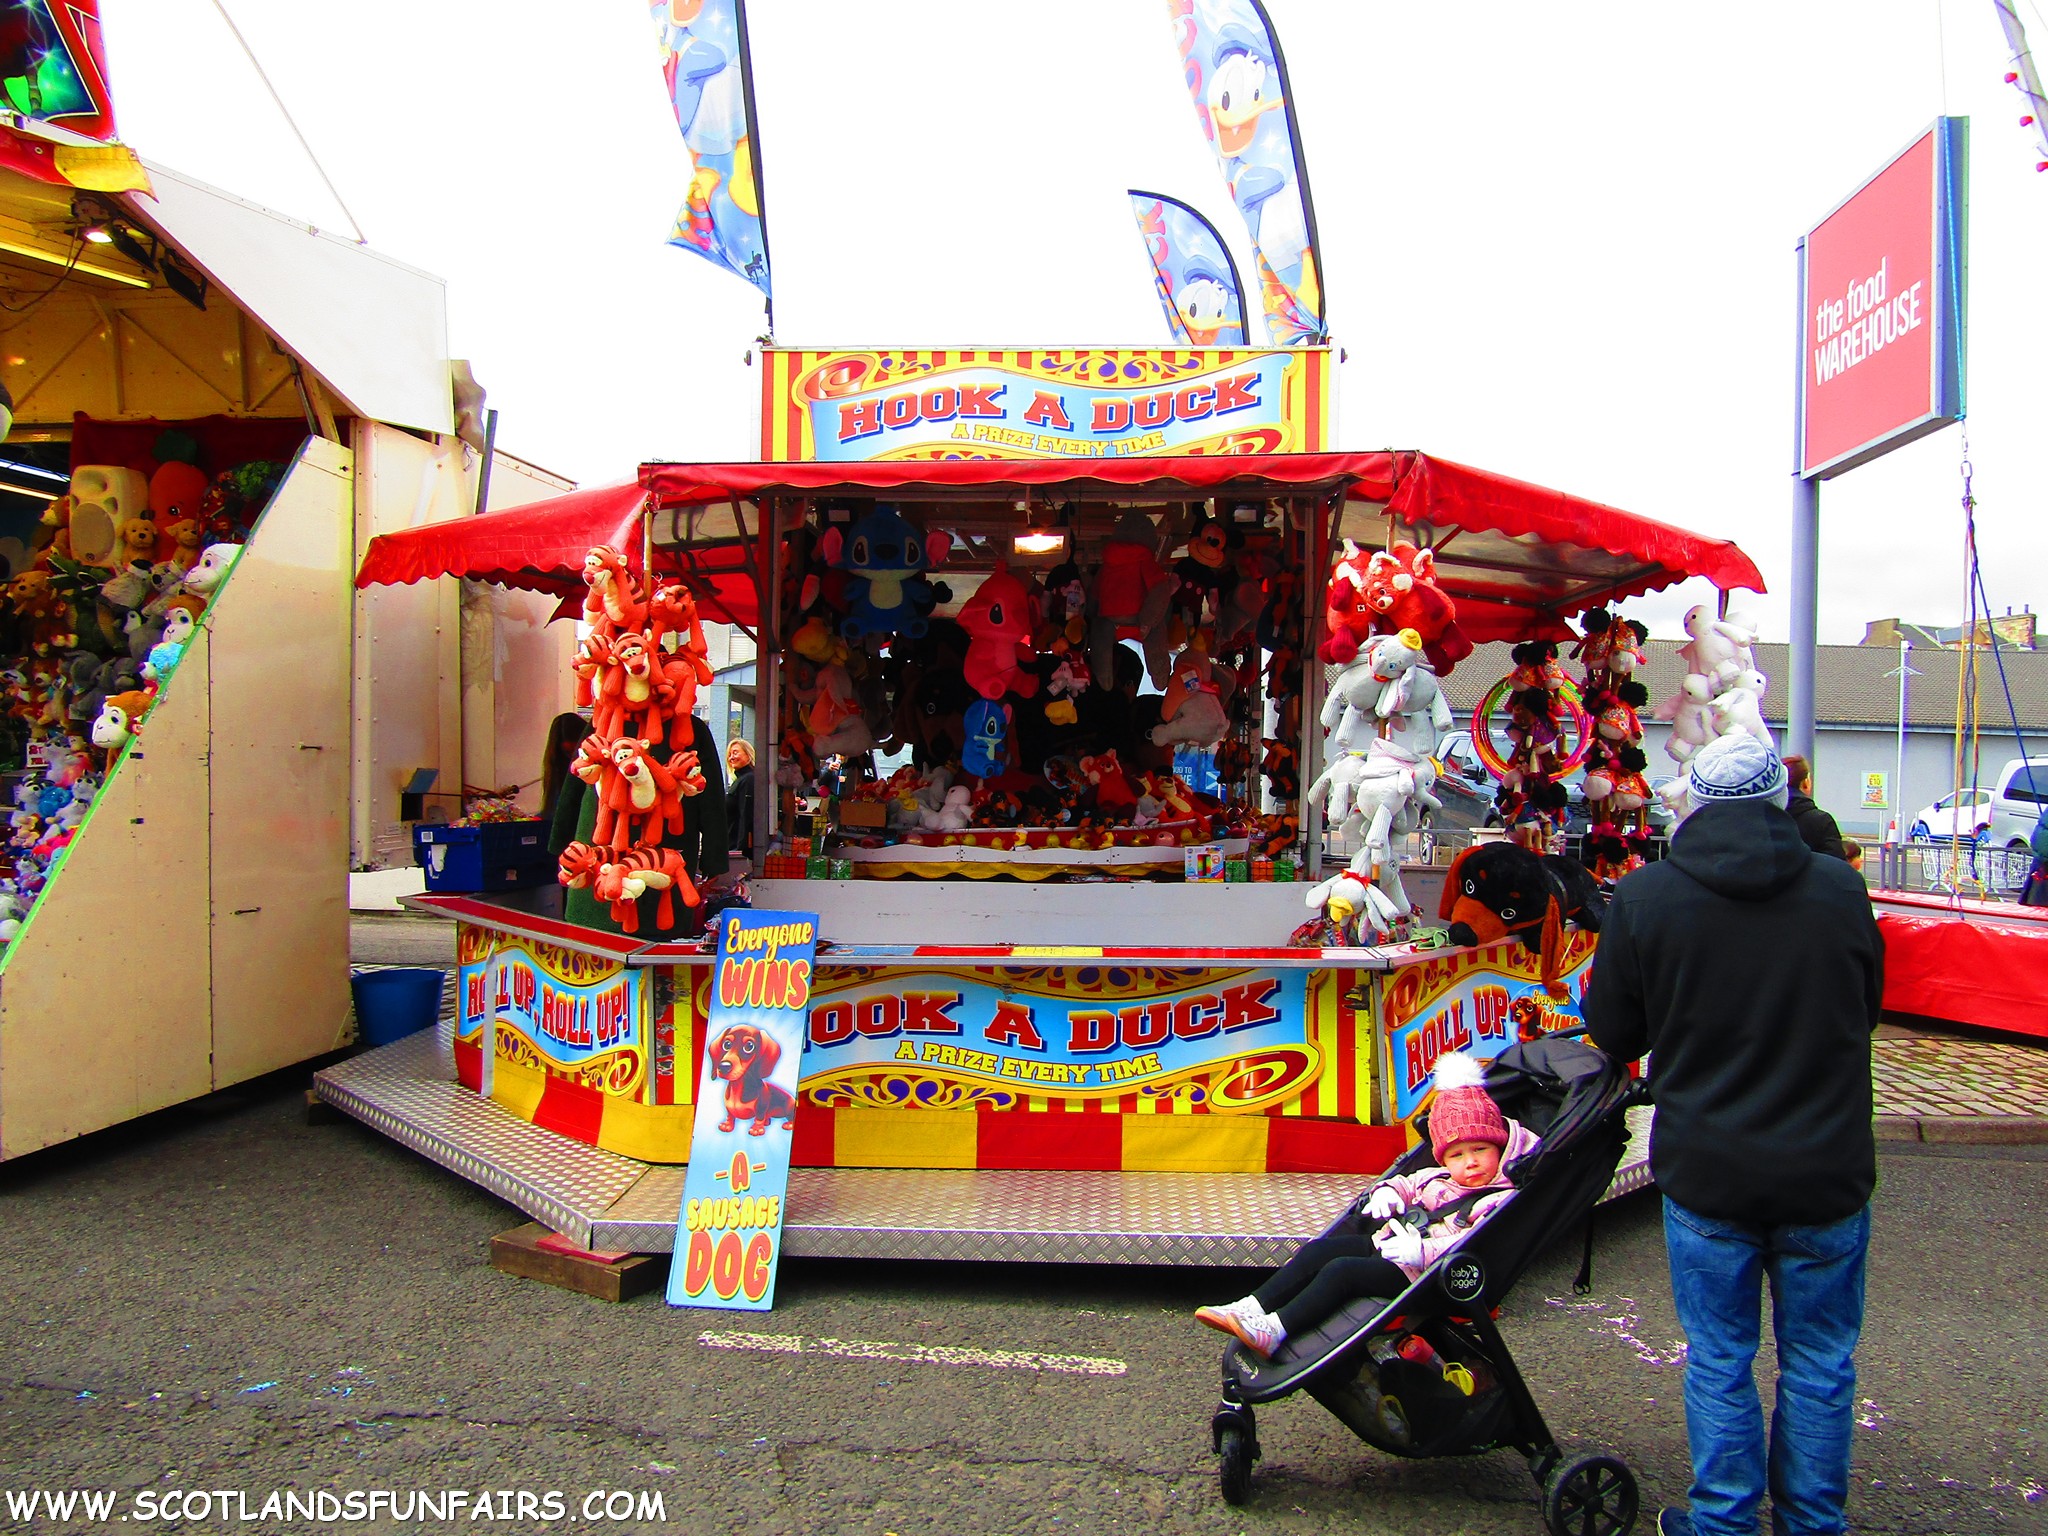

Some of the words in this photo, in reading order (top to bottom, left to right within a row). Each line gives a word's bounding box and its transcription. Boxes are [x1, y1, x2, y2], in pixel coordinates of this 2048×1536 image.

[1815, 299, 1843, 343] the
[1846, 256, 1887, 324] food
[1814, 280, 1922, 387] WAREHOUSE
[838, 383, 1006, 442] HOOK
[1023, 389, 1073, 430] A
[1091, 372, 1261, 433] DUCK
[951, 423, 969, 439] A
[973, 424, 1035, 449] PRIZE
[1036, 434, 1109, 456] EVERY
[1111, 431, 1166, 456] TIME
[726, 918, 814, 963] Everyone
[467, 964, 509, 1018] ROL
[542, 981, 591, 1046] ROLL
[596, 978, 629, 1043] UP!
[719, 957, 811, 1010] WINS
[802, 990, 960, 1049] OOK
[983, 1000, 1044, 1050] A
[1067, 977, 1278, 1052] DUCK
[1405, 996, 1471, 1094] ROLL
[1473, 983, 1509, 1037] UP
[895, 1041, 917, 1060] A
[921, 1042, 999, 1073] PRIZE
[1001, 1056, 1091, 1083] EVERY
[1094, 1051, 1162, 1083] TIME
[686, 1196, 780, 1232] SAUSAGE
[685, 1229, 774, 1302] DOG
[1450, 1278, 1478, 1289] jogger
[1451, 1267, 1471, 1279] baby
